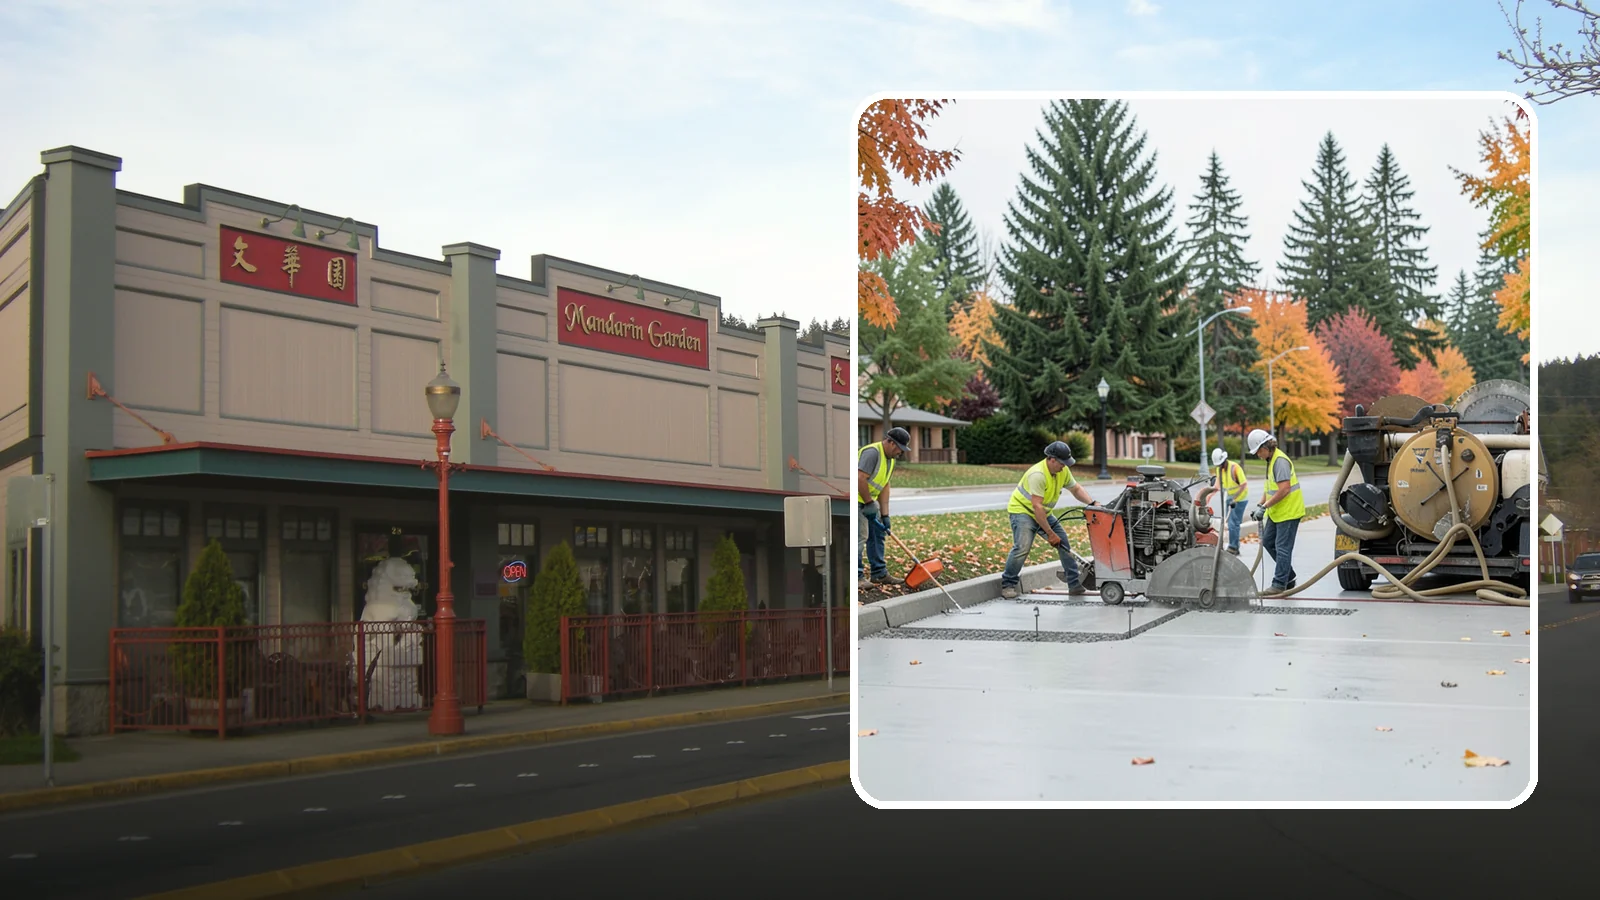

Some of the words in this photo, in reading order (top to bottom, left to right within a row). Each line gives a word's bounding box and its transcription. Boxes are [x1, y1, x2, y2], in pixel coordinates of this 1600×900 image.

[231, 236, 346, 290] 文華園
[565, 302, 644, 341] Mandarin
[648, 320, 702, 352] Garden
[835, 363, 846, 386] 文
[503, 565, 527, 578] OPEN
